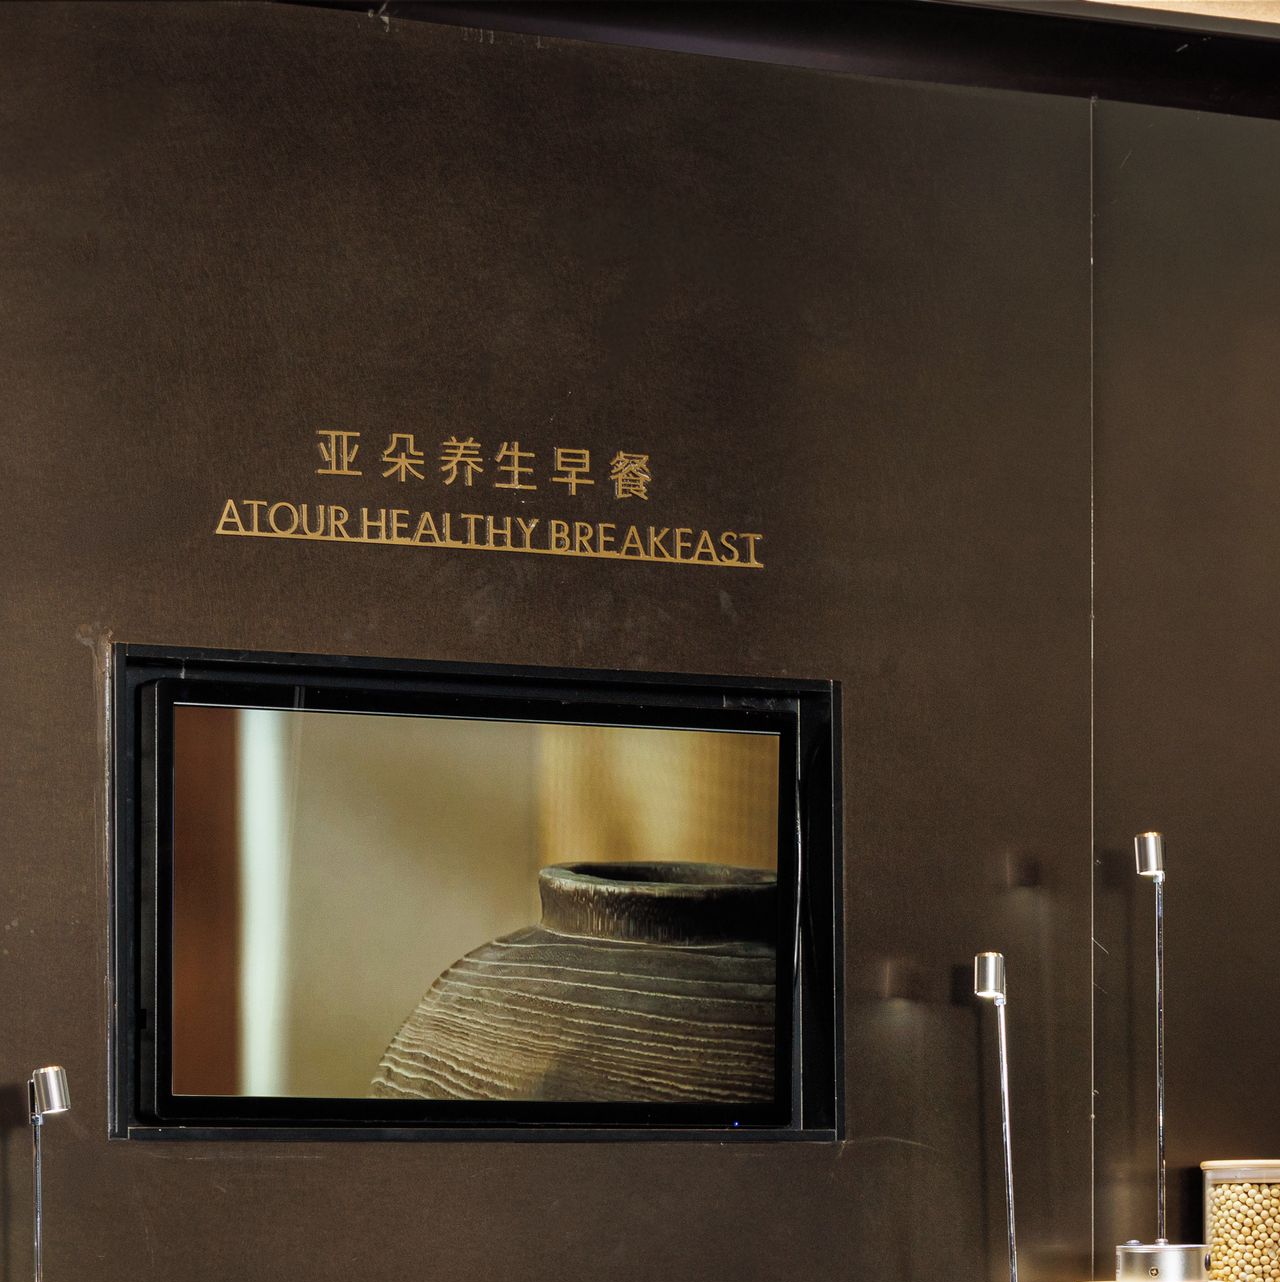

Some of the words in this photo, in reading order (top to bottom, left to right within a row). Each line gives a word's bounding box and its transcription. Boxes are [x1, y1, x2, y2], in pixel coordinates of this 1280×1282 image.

[315, 429, 650, 500] 亚朵养生早餐
[216, 498, 350, 541] ATOUR
[360, 507, 538, 551] HEALTHY
[548, 520, 764, 568] BREAKFAST
